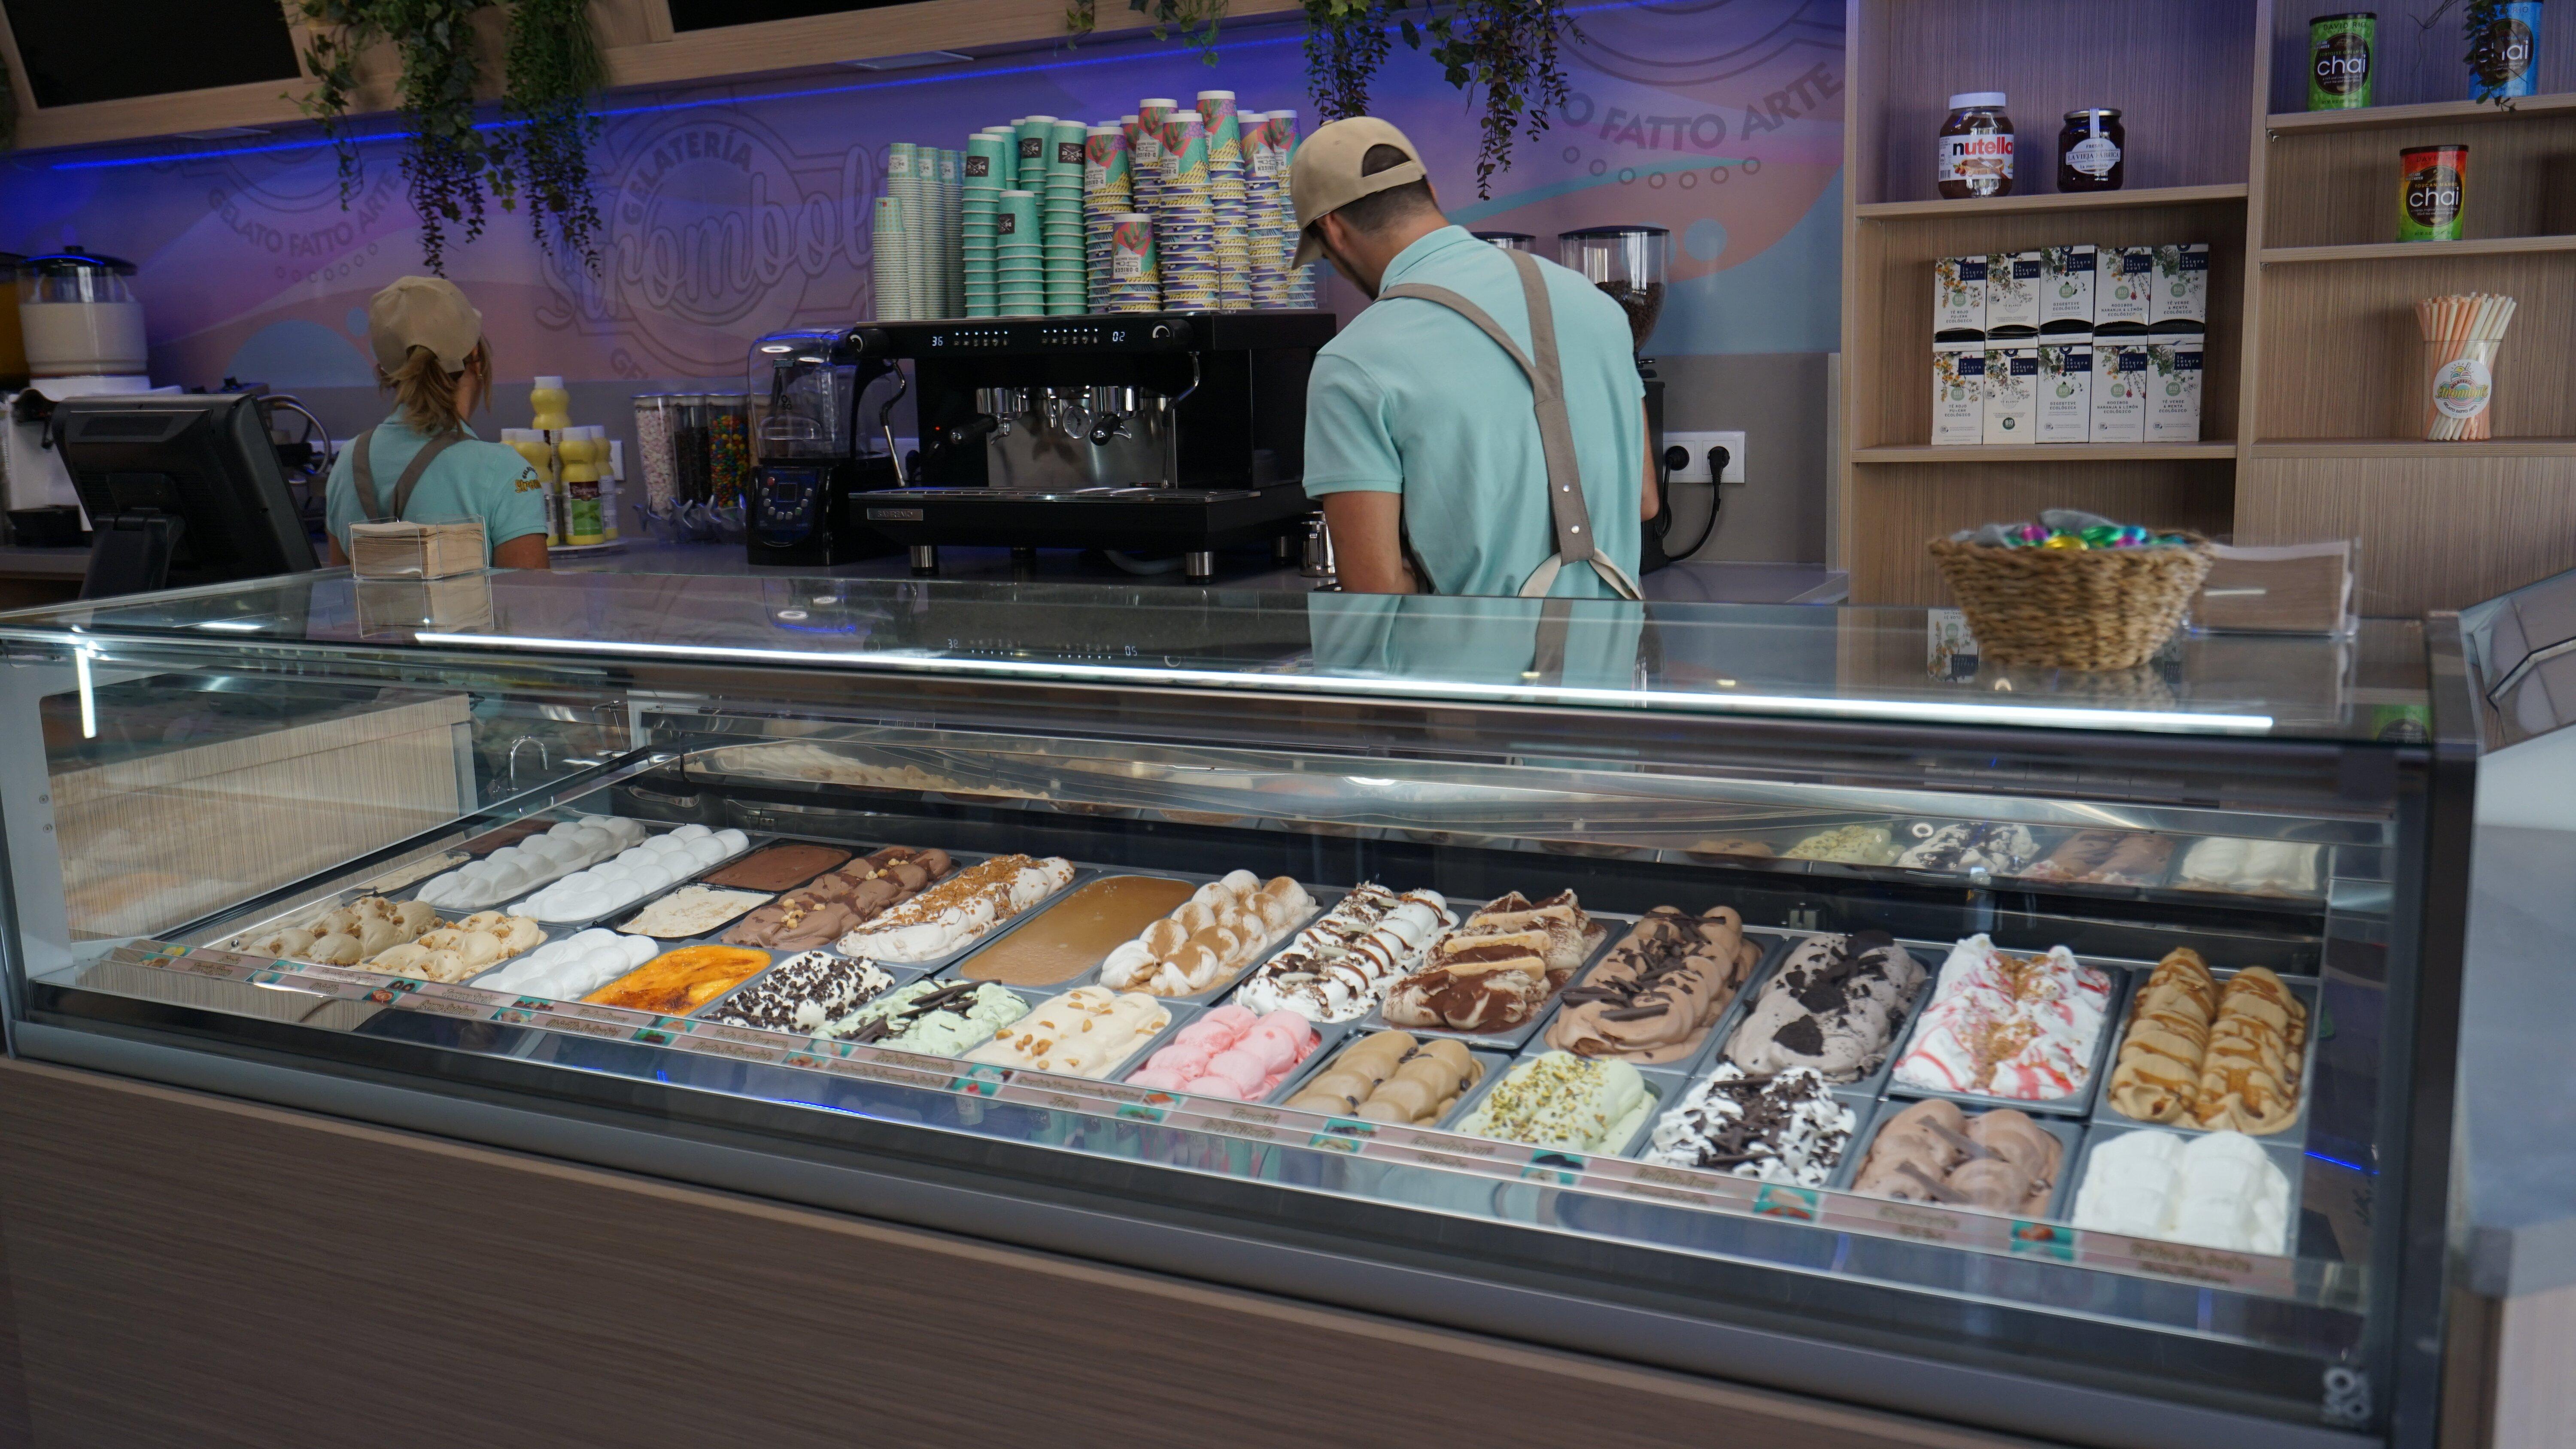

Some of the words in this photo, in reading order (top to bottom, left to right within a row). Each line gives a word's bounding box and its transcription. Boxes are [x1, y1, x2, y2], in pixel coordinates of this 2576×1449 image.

[2317, 53, 2366, 76] chai
[1598, 106, 1726, 152] FATTO
[1741, 61, 1844, 141] ARTE
[1953, 136, 2013, 156] nutella
[2409, 186, 2459, 207] chai
[289, 222, 353, 258] FATTO
[932, 336, 943, 346] 36
[1112, 331, 1125, 342] 02
